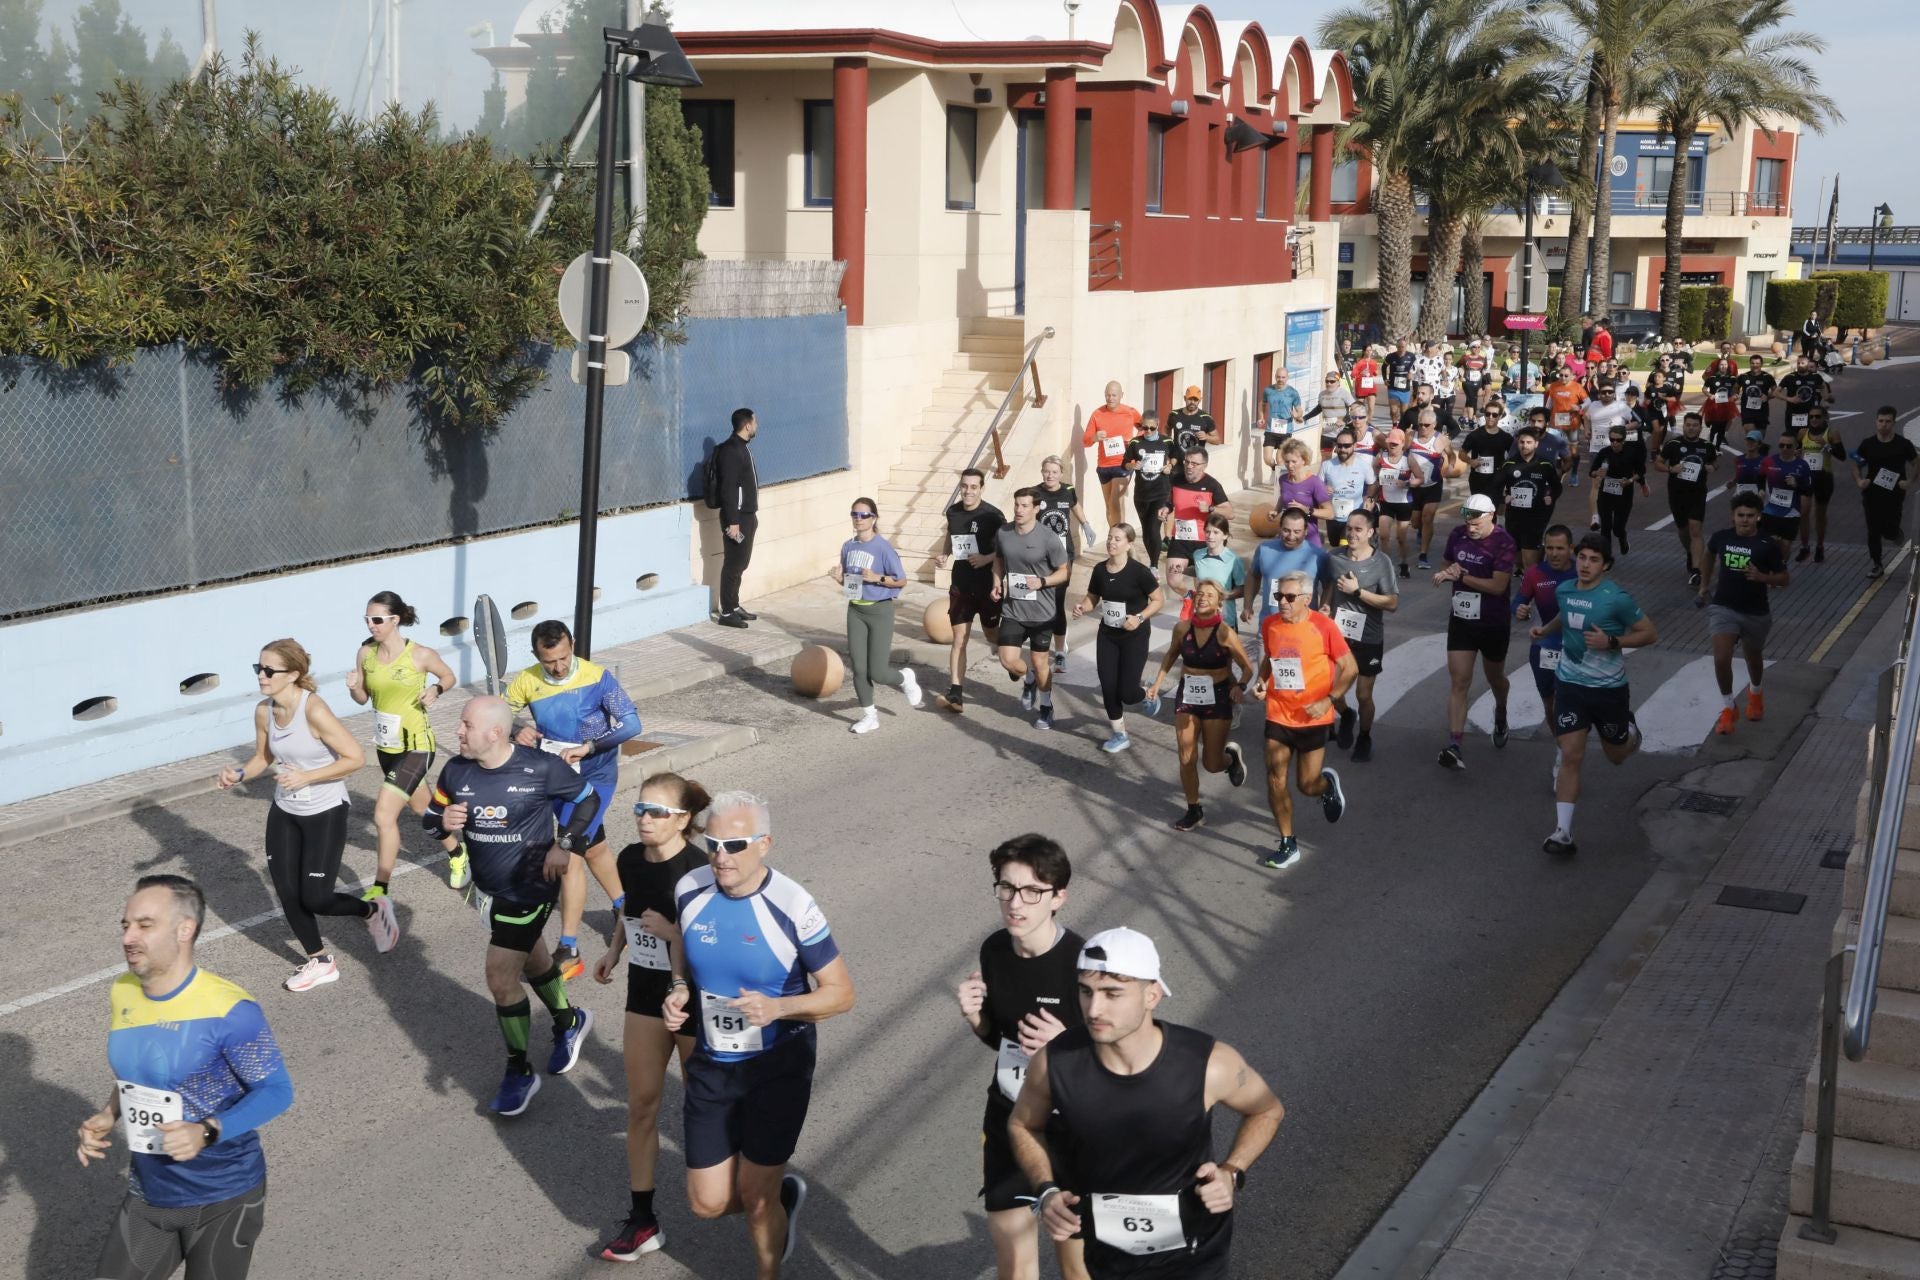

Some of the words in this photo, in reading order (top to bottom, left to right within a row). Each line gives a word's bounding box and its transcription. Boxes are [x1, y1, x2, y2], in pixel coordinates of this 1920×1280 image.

[1724, 553, 1751, 569] 15K
[1460, 601, 1471, 609] 49
[1107, 610, 1120, 618] 430
[1341, 618, 1358, 628] 152
[1278, 669, 1295, 677] 356
[1189, 685, 1207, 694] 355
[473, 806, 507, 819] 200
[634, 932, 657, 949] 353
[712, 1014, 744, 1031] 151
[128, 1107, 164, 1127] 399
[1123, 1217, 1154, 1232] 63
